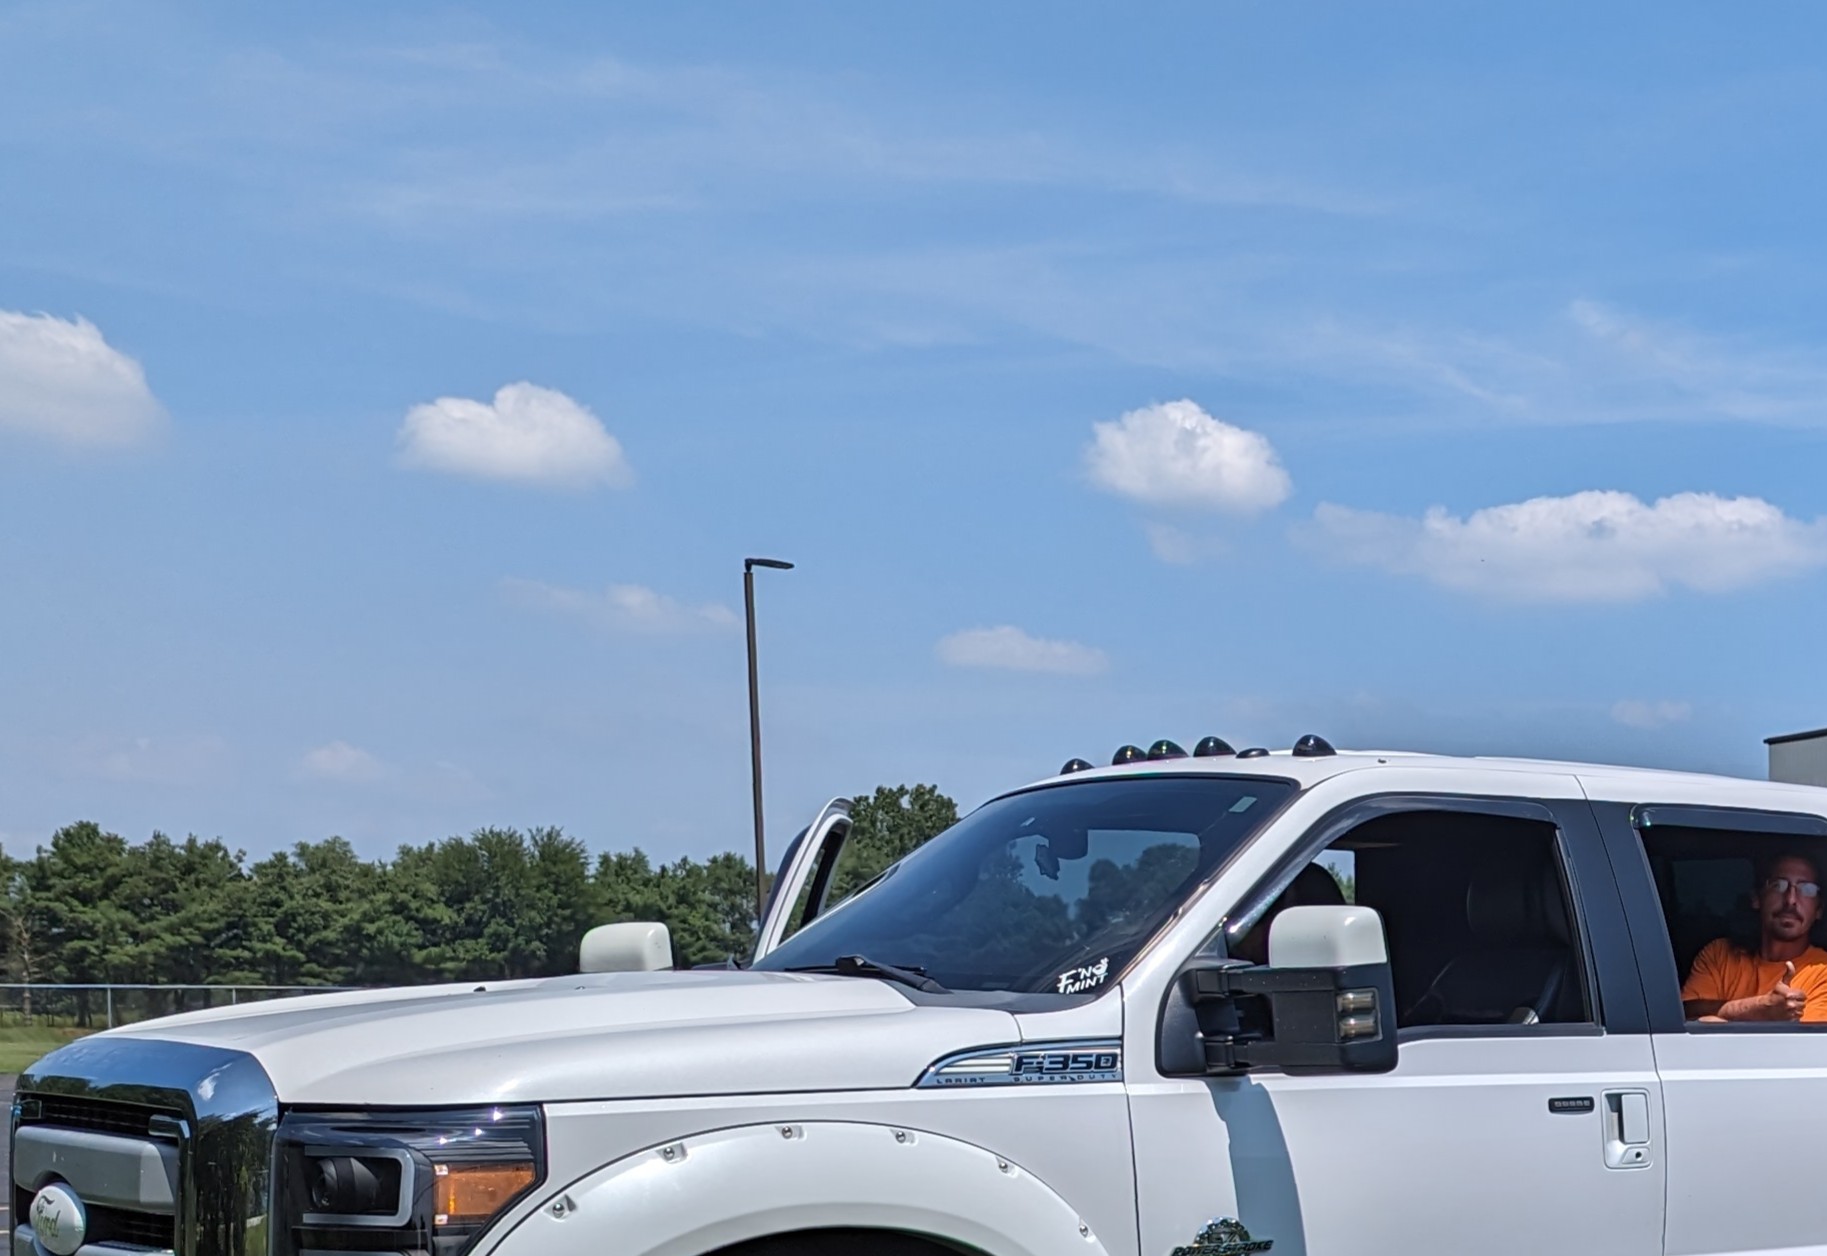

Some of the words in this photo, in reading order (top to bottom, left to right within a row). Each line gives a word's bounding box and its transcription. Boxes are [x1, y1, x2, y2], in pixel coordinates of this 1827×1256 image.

[1066, 972, 1108, 994] MINT
[1013, 1053, 1119, 1074] F-350
[936, 1076, 985, 1084] LARIAT
